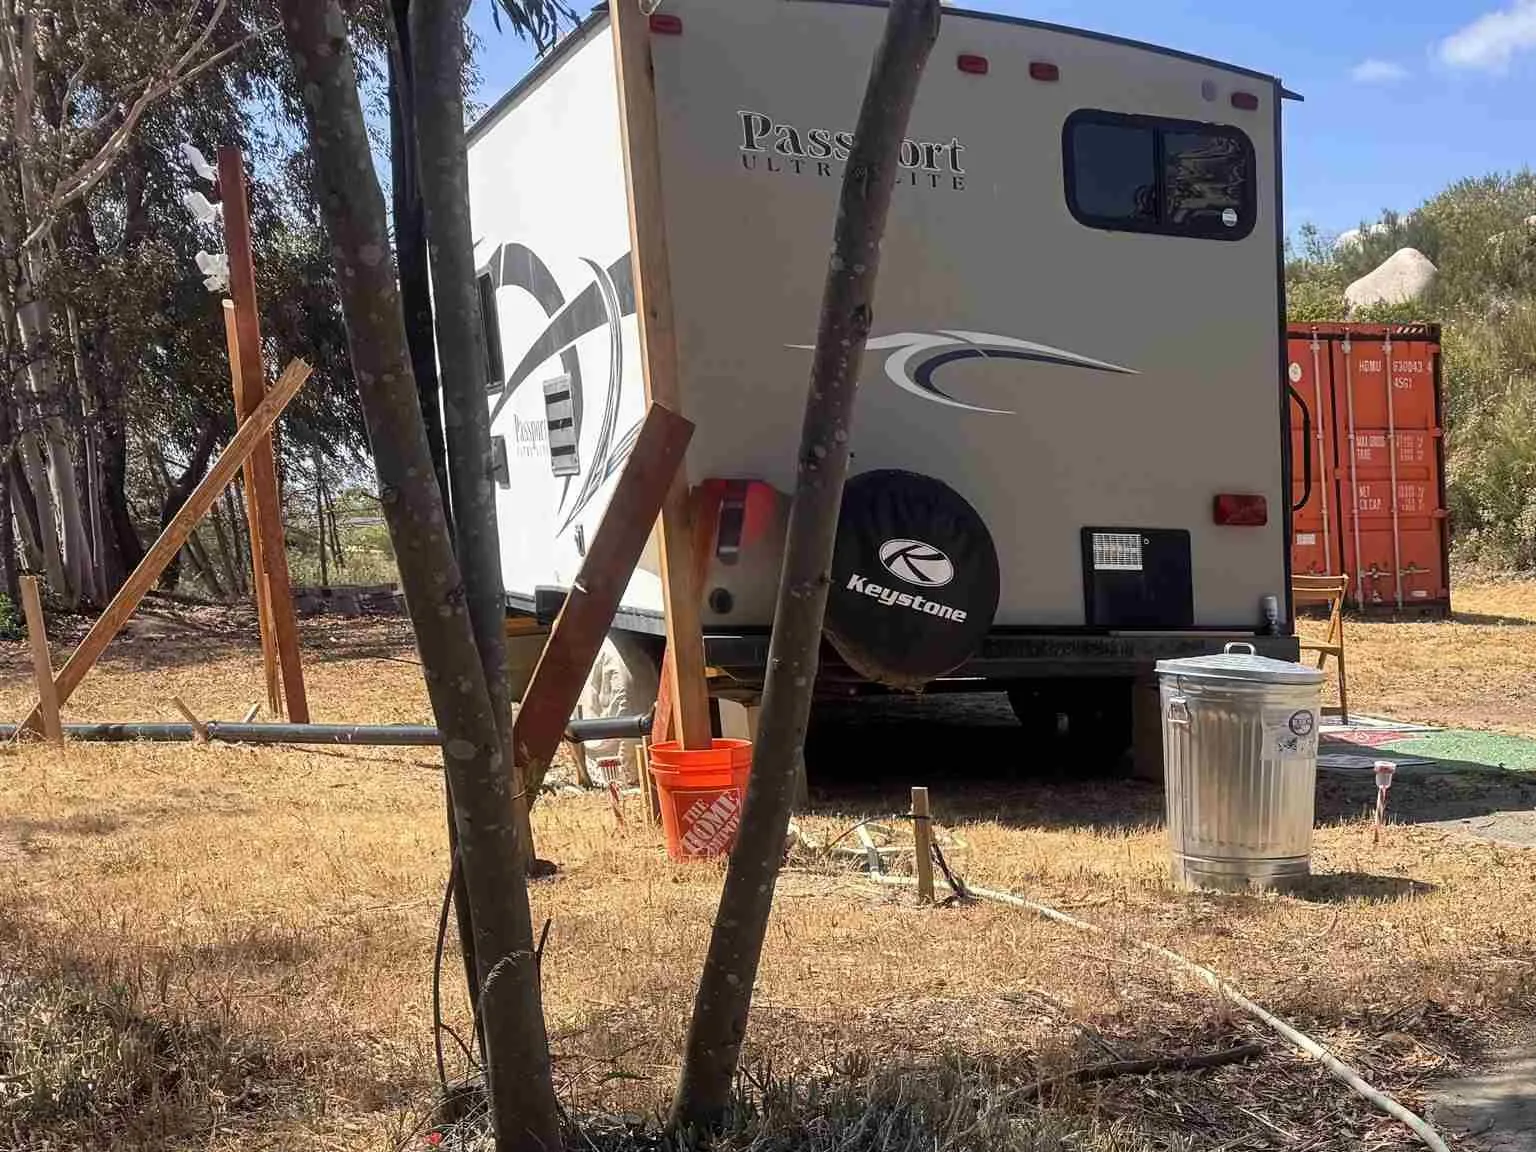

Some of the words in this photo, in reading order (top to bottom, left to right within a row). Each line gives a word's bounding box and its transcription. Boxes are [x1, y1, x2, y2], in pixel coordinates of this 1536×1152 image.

[736, 110, 967, 174] Passort
[742, 154, 846, 180] ULTR
[894, 171, 967, 191] ITE
[847, 573, 967, 623] Keystone
[682, 799, 709, 823] THE
